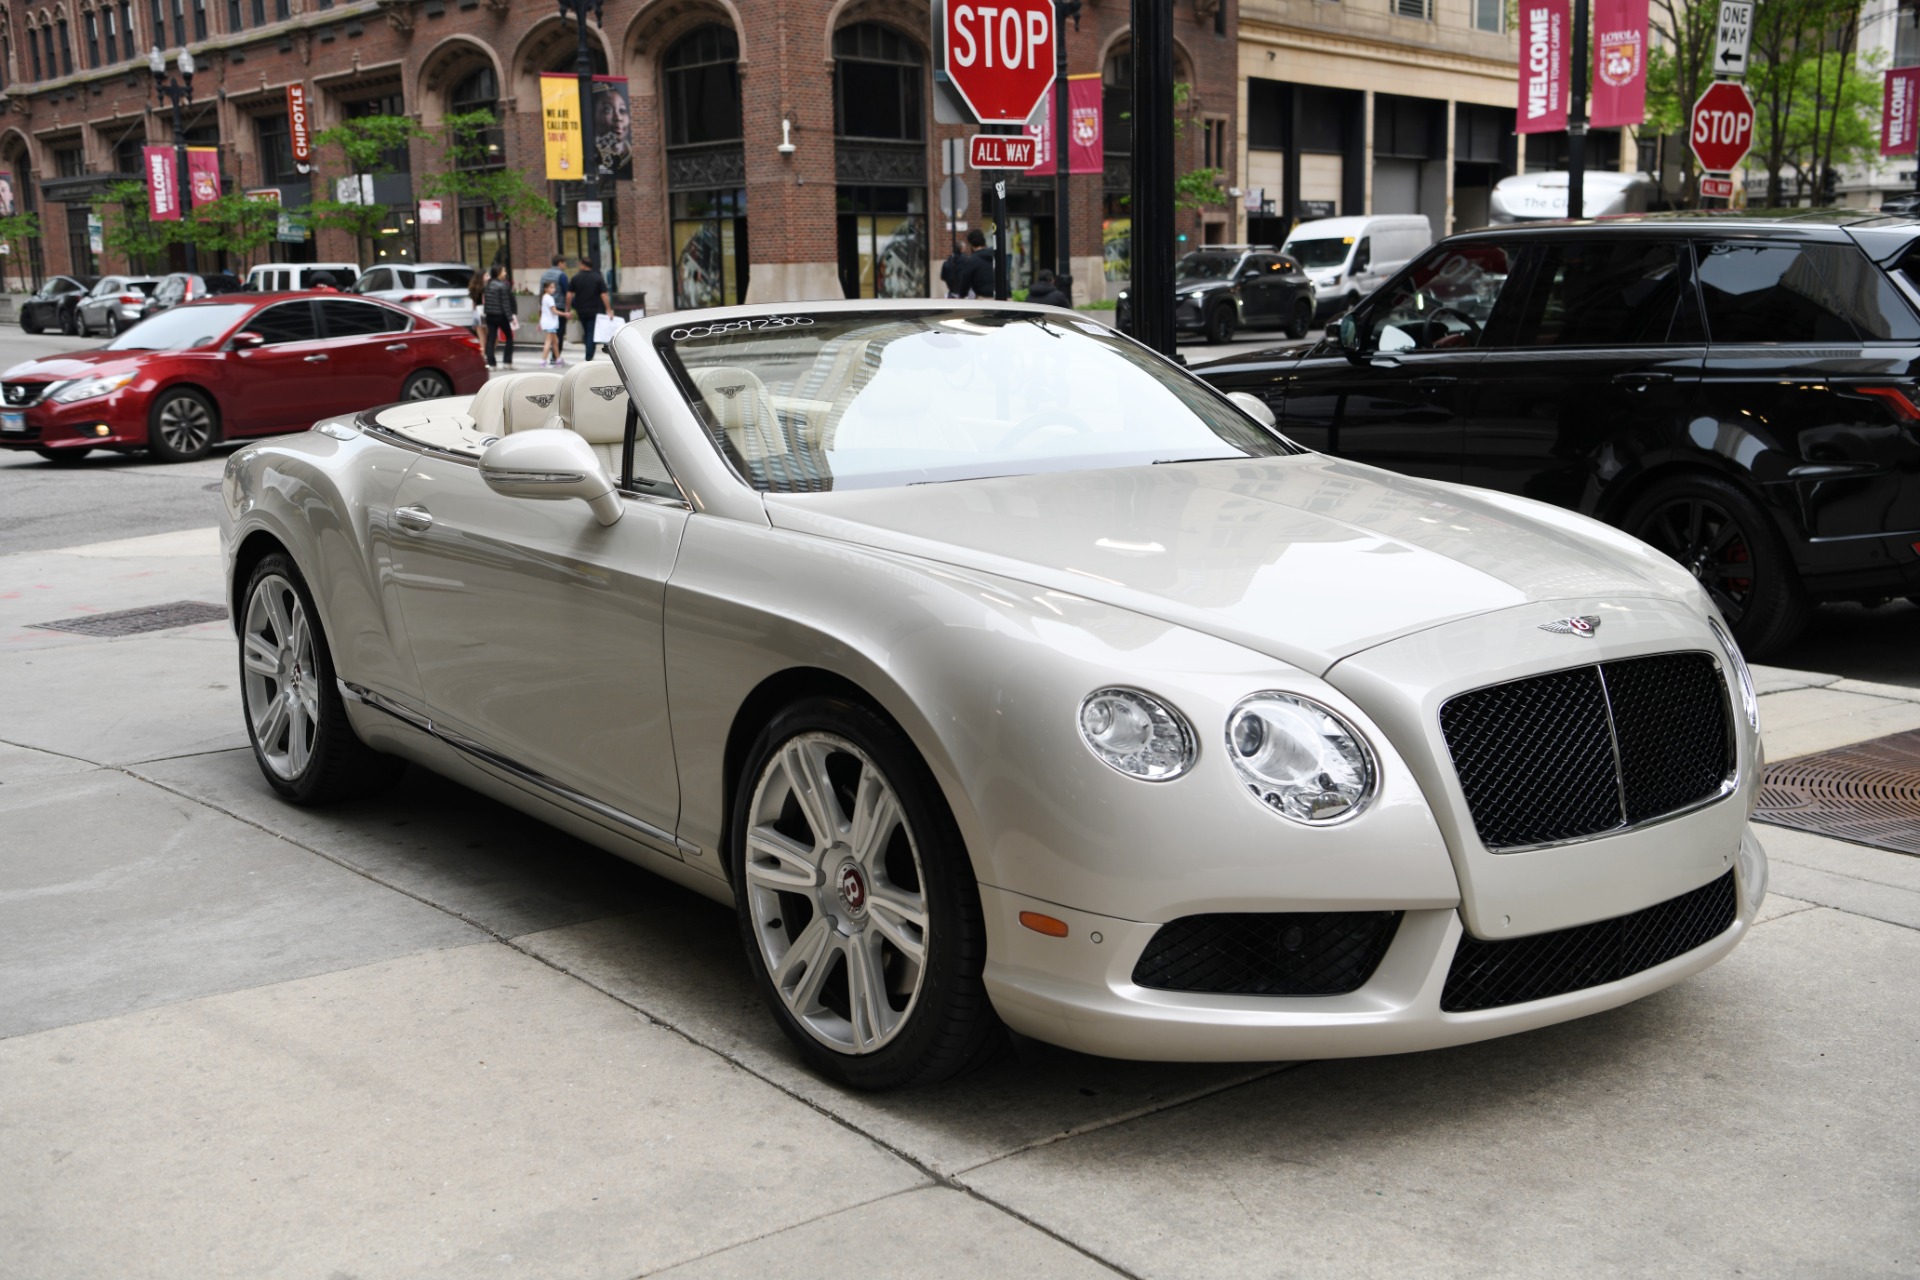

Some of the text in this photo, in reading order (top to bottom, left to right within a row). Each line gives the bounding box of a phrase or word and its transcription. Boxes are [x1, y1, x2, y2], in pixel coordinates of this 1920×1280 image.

[1720, 27, 1747, 44] WAY
[1723, 7, 1748, 25] ONE
[954, 4, 1049, 70] STOP
[1527, 8, 1548, 119] WELCOME
[292, 88, 308, 157] CHIPOTLE
[1695, 109, 1750, 145] STOP
[1888, 77, 1906, 147] WELCOME
[977, 143, 1030, 162] ALL WAY
[1029, 125, 1043, 166] WELC
[150, 154, 168, 213] WELCOME
[1524, 198, 1547, 208] The
